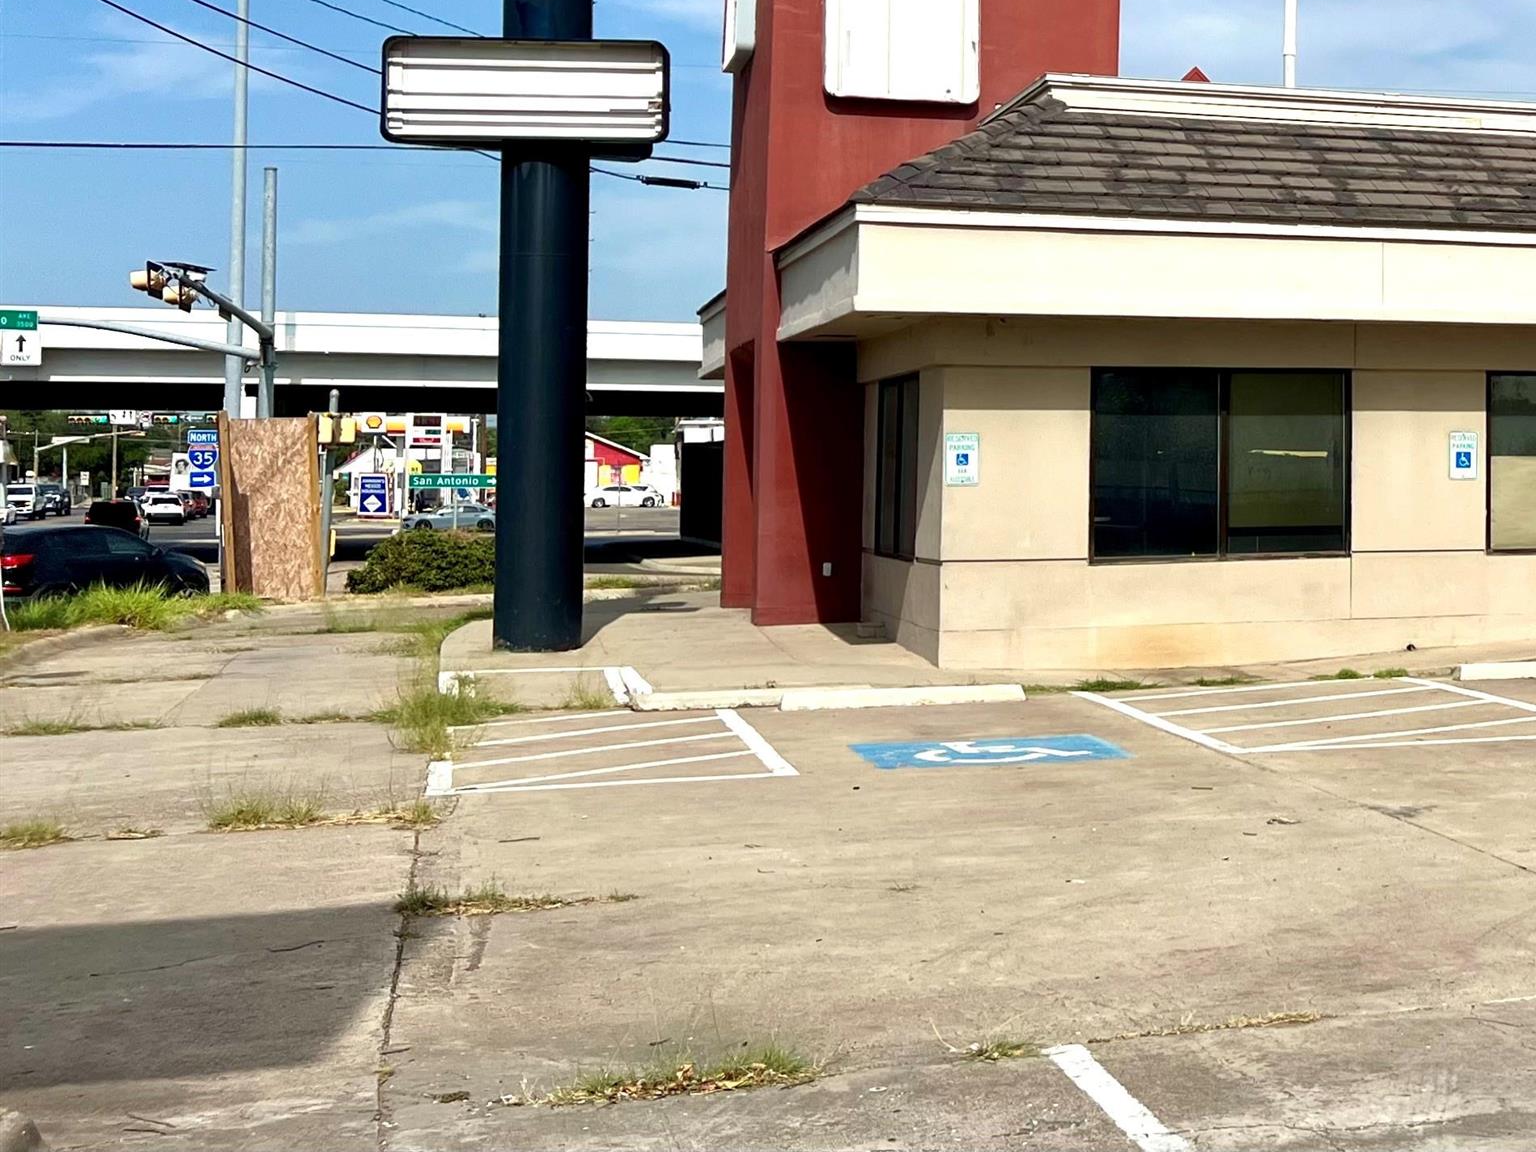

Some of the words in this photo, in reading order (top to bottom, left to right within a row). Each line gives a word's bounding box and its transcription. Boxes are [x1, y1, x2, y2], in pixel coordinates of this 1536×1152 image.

[190, 433, 217, 442] NORTH
[193, 452, 213, 465] 35
[412, 477, 433, 485] San
[436, 477, 479, 485] Antonio
